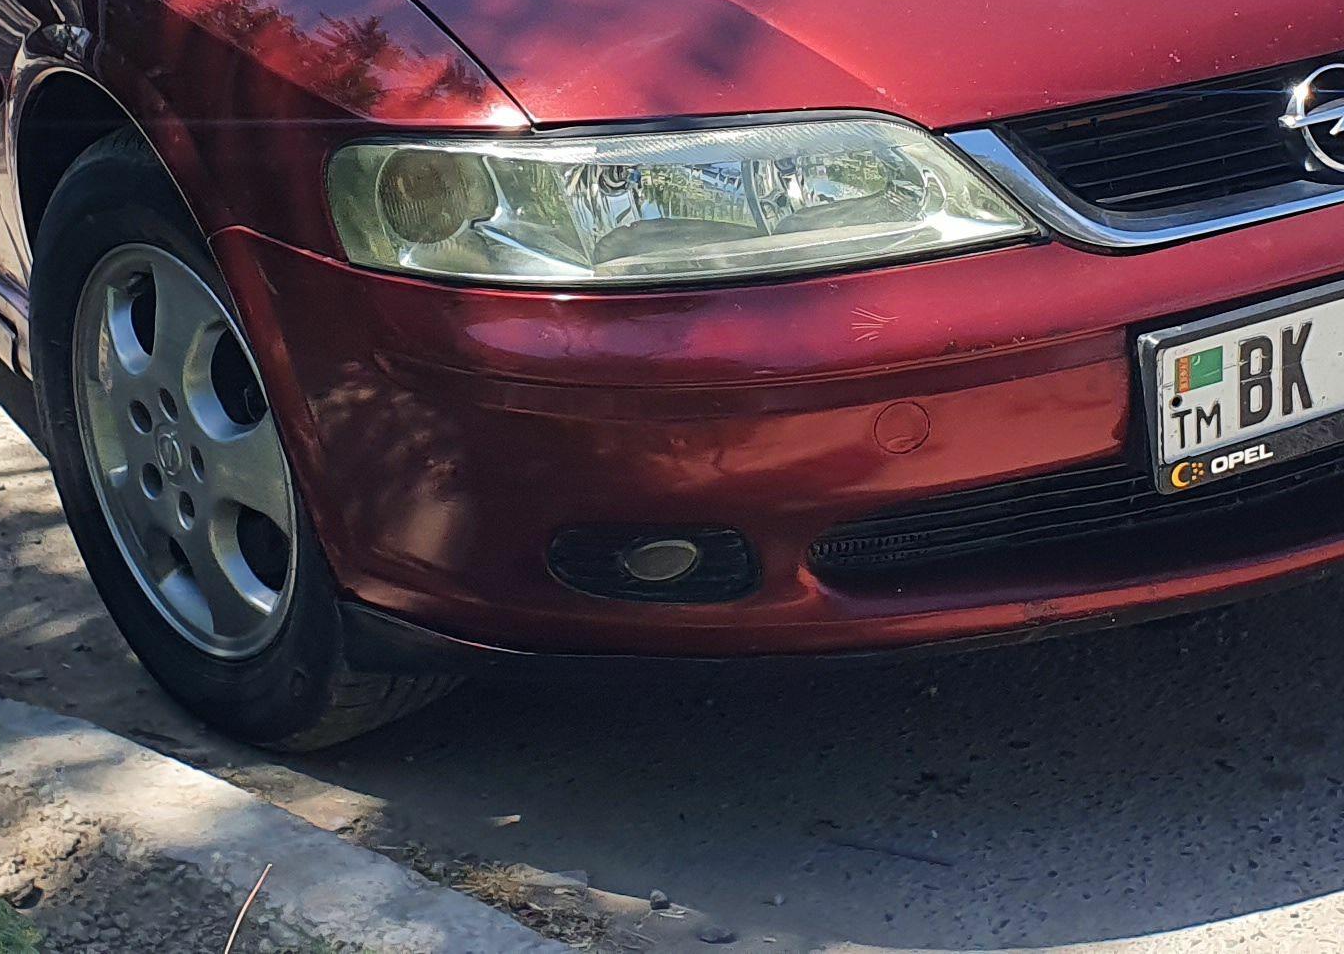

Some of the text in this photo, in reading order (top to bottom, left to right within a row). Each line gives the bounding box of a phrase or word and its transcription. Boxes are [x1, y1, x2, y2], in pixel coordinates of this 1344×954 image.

[1239, 321, 1313, 429] BK
[1171, 399, 1222, 449] TM
[1210, 444, 1274, 475] OPEL
